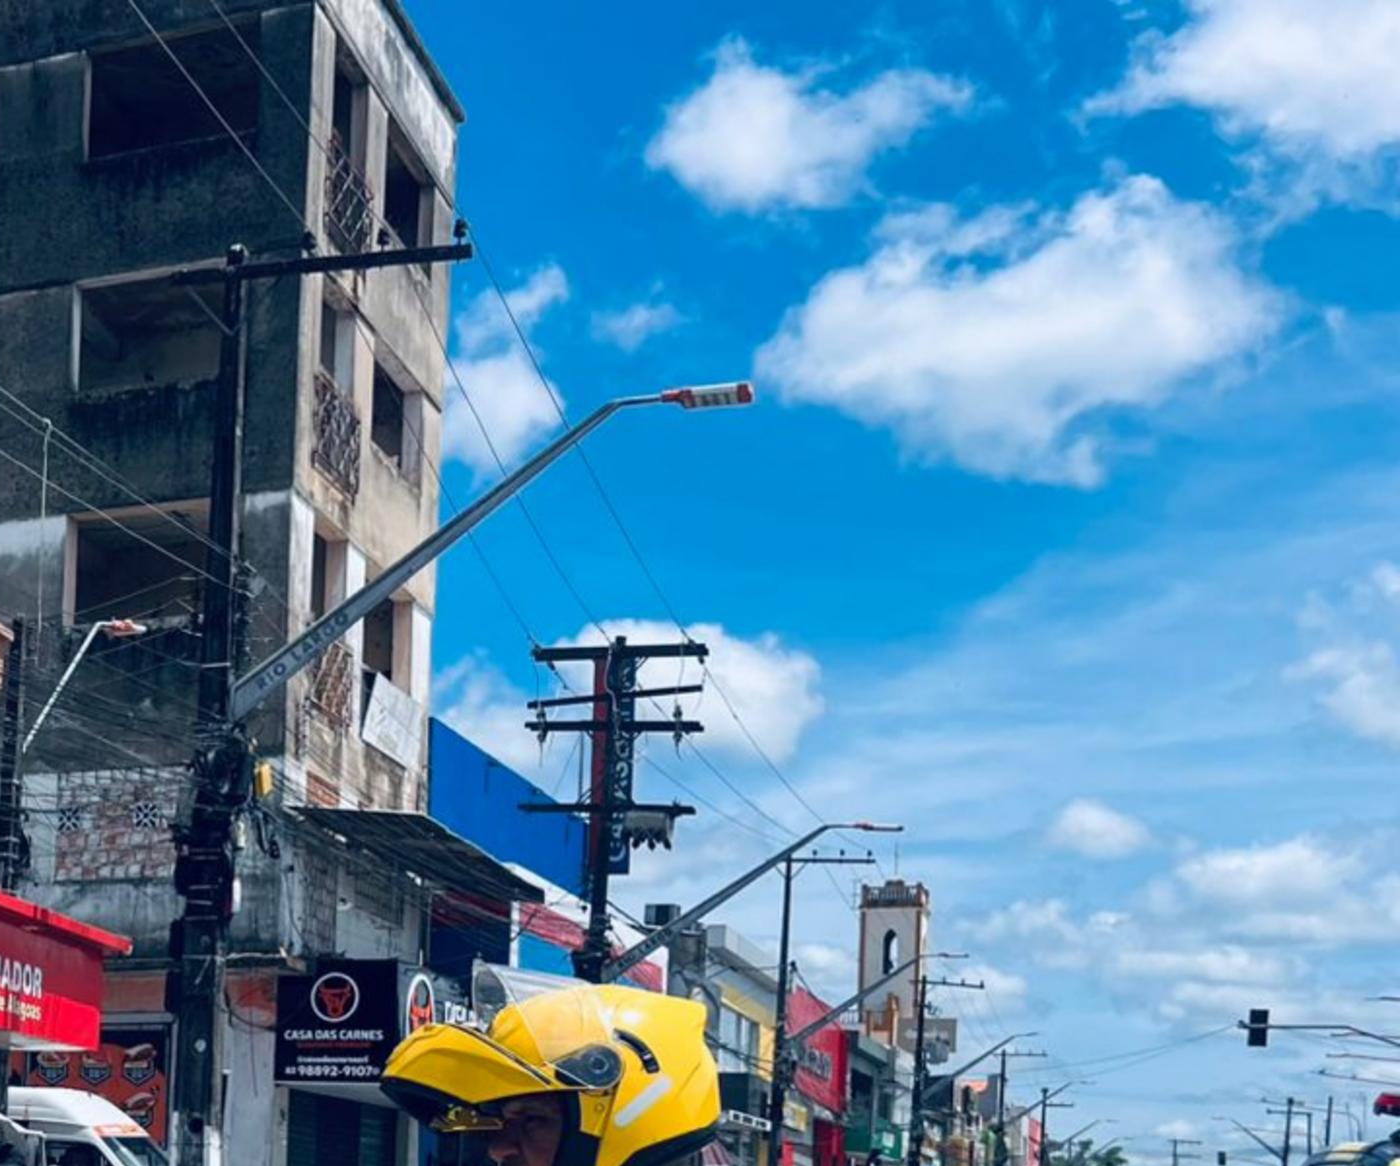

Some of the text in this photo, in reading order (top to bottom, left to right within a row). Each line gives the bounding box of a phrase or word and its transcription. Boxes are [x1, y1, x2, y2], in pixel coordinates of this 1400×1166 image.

[257, 611, 348, 690] RIO LARGO
[284, 1029, 384, 1041] CASA DAS CARNES
